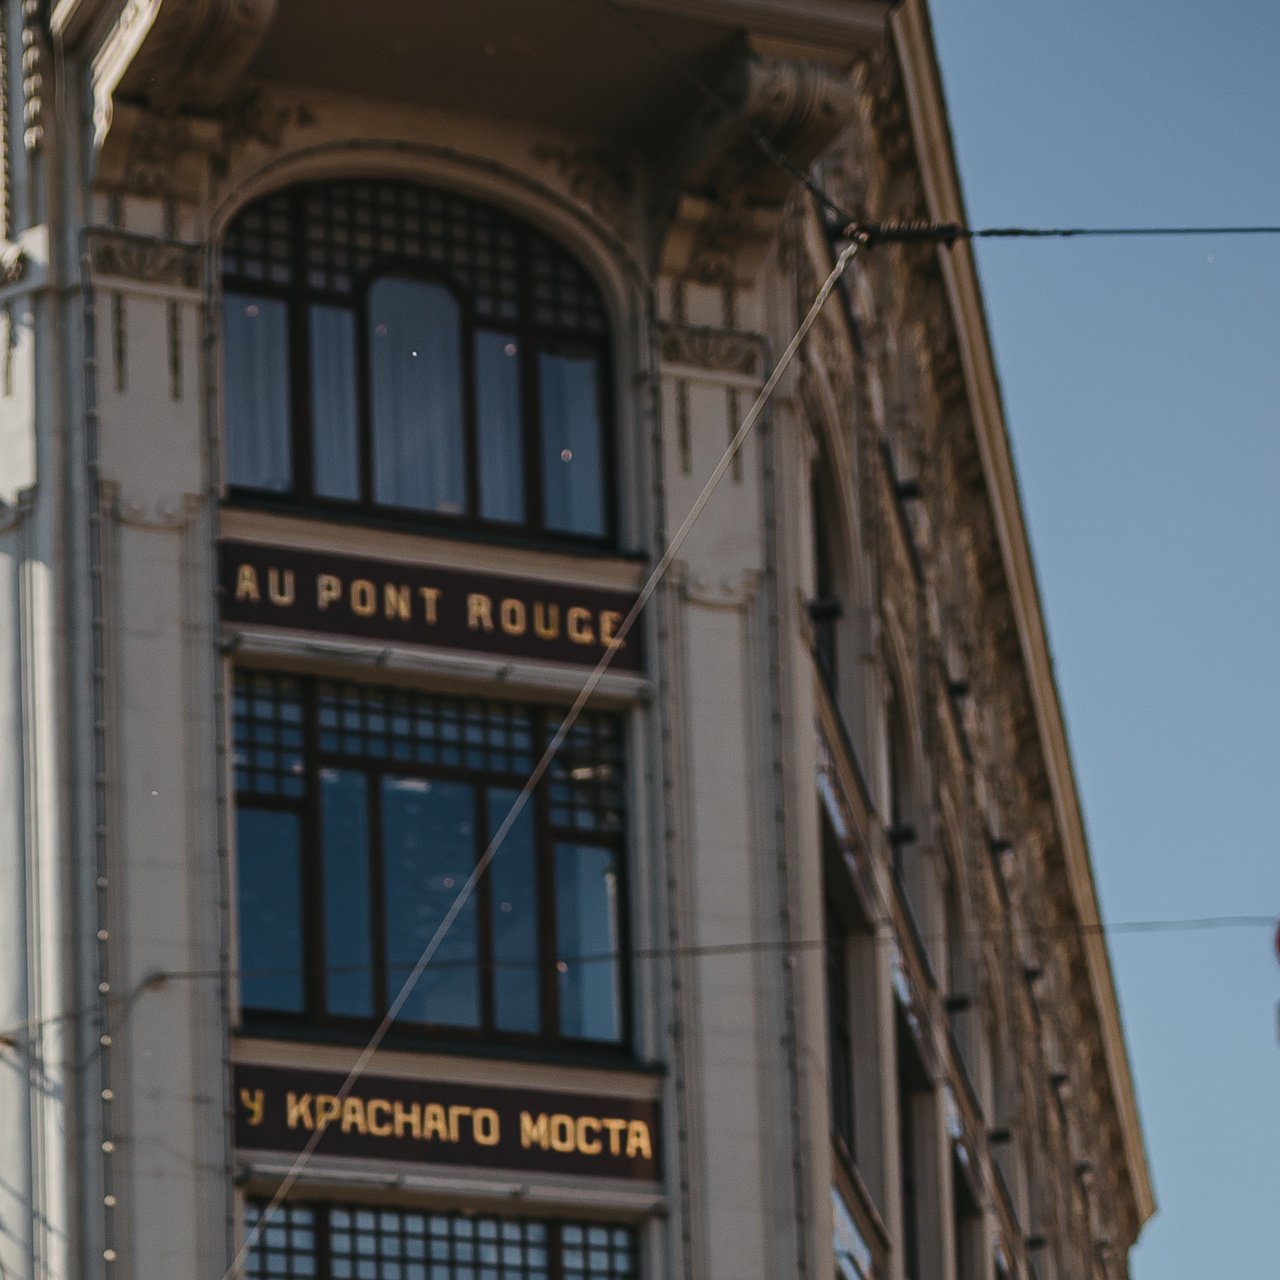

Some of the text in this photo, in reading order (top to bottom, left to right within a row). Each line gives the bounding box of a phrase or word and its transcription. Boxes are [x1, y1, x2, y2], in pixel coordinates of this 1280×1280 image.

[236, 563, 625, 648] AU PONT ROUGE
[240, 1087, 652, 1160] У КРАСНАГО МОСТА
